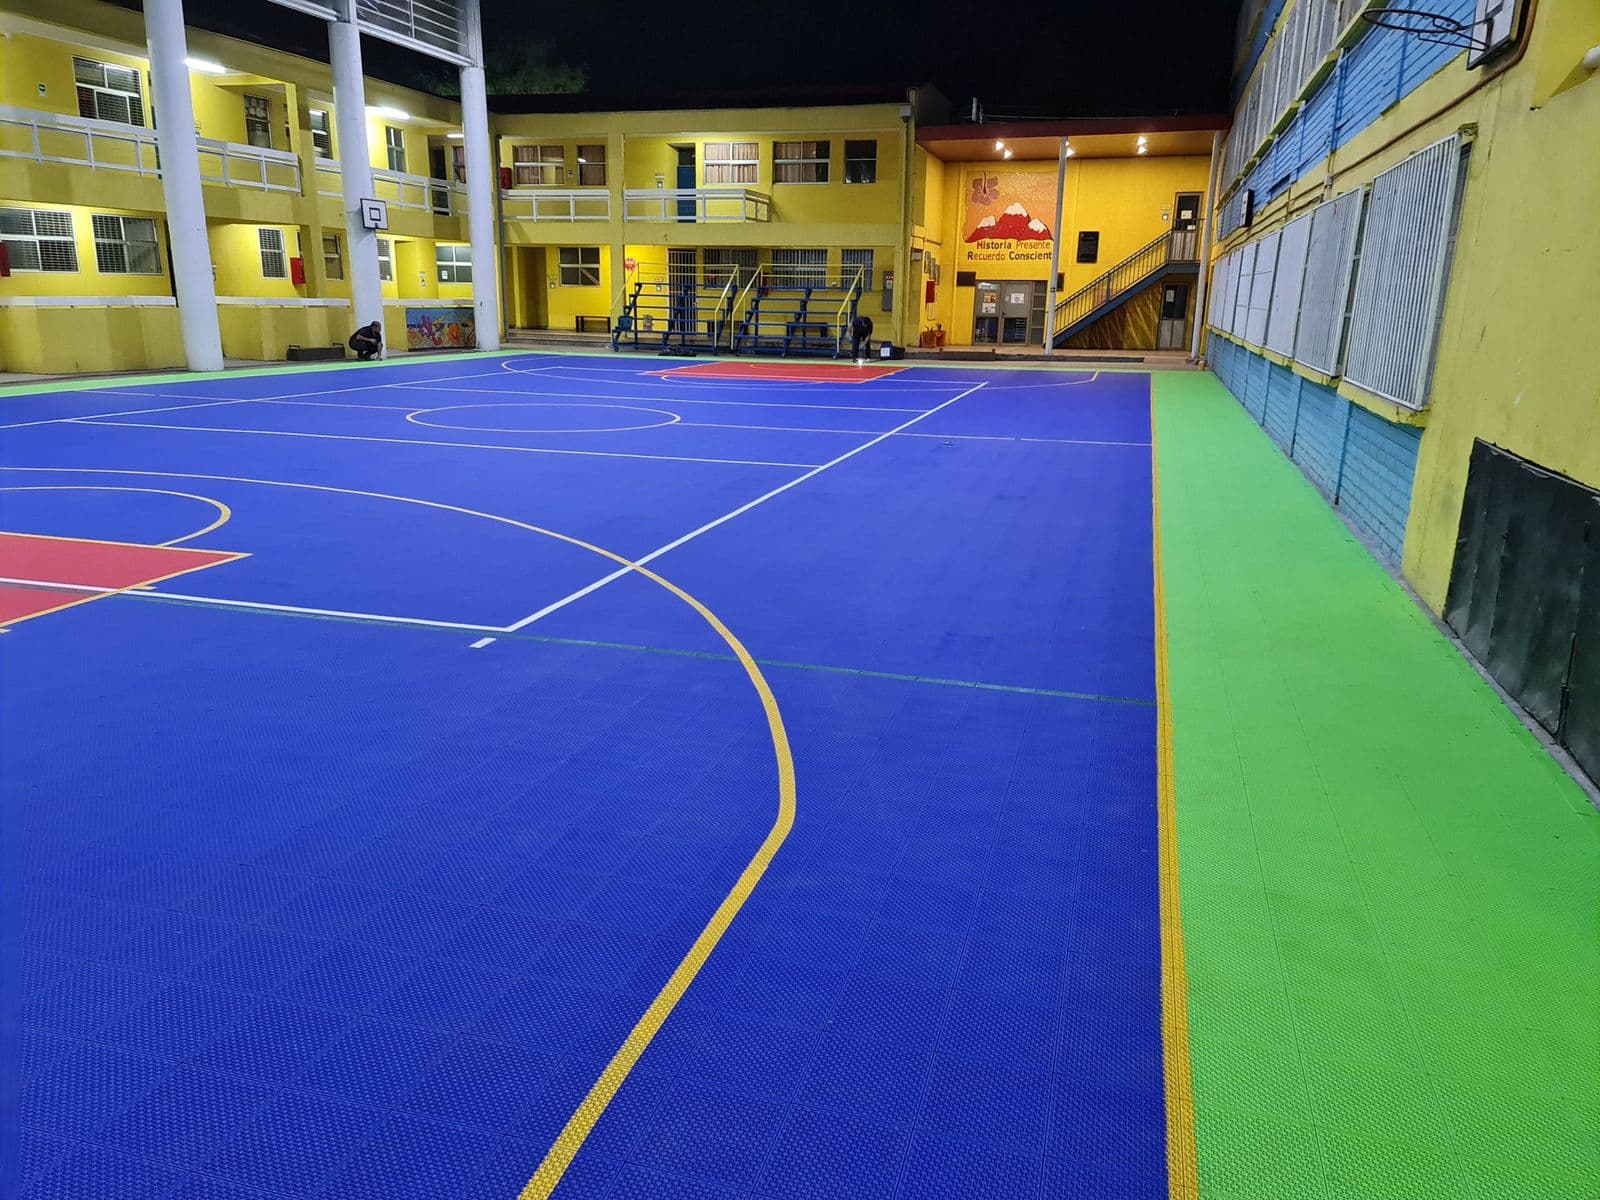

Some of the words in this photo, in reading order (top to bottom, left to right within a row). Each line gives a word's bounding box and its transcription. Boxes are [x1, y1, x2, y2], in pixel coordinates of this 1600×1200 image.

[976, 240, 1012, 250] Historia
[1016, 240, 1051, 250] Presente
[967, 251, 1006, 261] Recuerdo
[1008, 251, 1053, 260] Conscient
